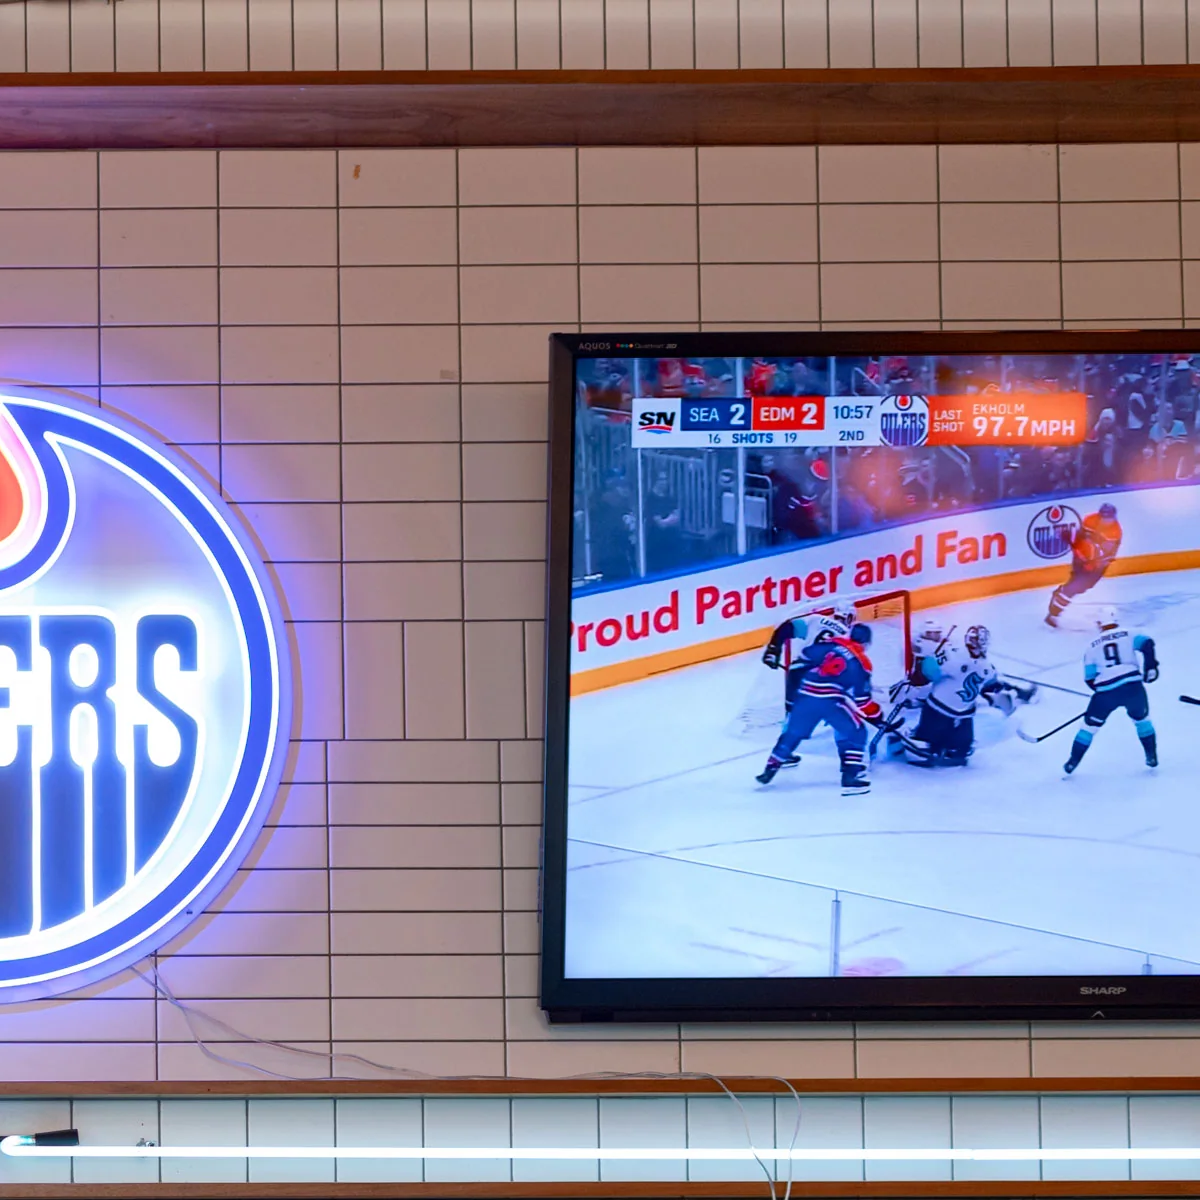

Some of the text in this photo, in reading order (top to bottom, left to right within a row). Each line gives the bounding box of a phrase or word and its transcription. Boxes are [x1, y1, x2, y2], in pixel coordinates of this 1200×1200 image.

[578, 342, 611, 351] AQUOS
[689, 403, 873, 425] SEA 2 EDM 2 10:57
[933, 409, 963, 421] LAST
[972, 403, 1025, 415] EKHOLM
[639, 411, 676, 427] SN
[932, 421, 965, 433] SHOT
[708, 432, 797, 444] 16 SHOTS 19
[839, 430, 864, 441] 2ND
[570, 530, 1007, 652] roud Partner and Fan
[1103, 643, 1121, 667] 9
[1079, 986, 1127, 995] SHARP
